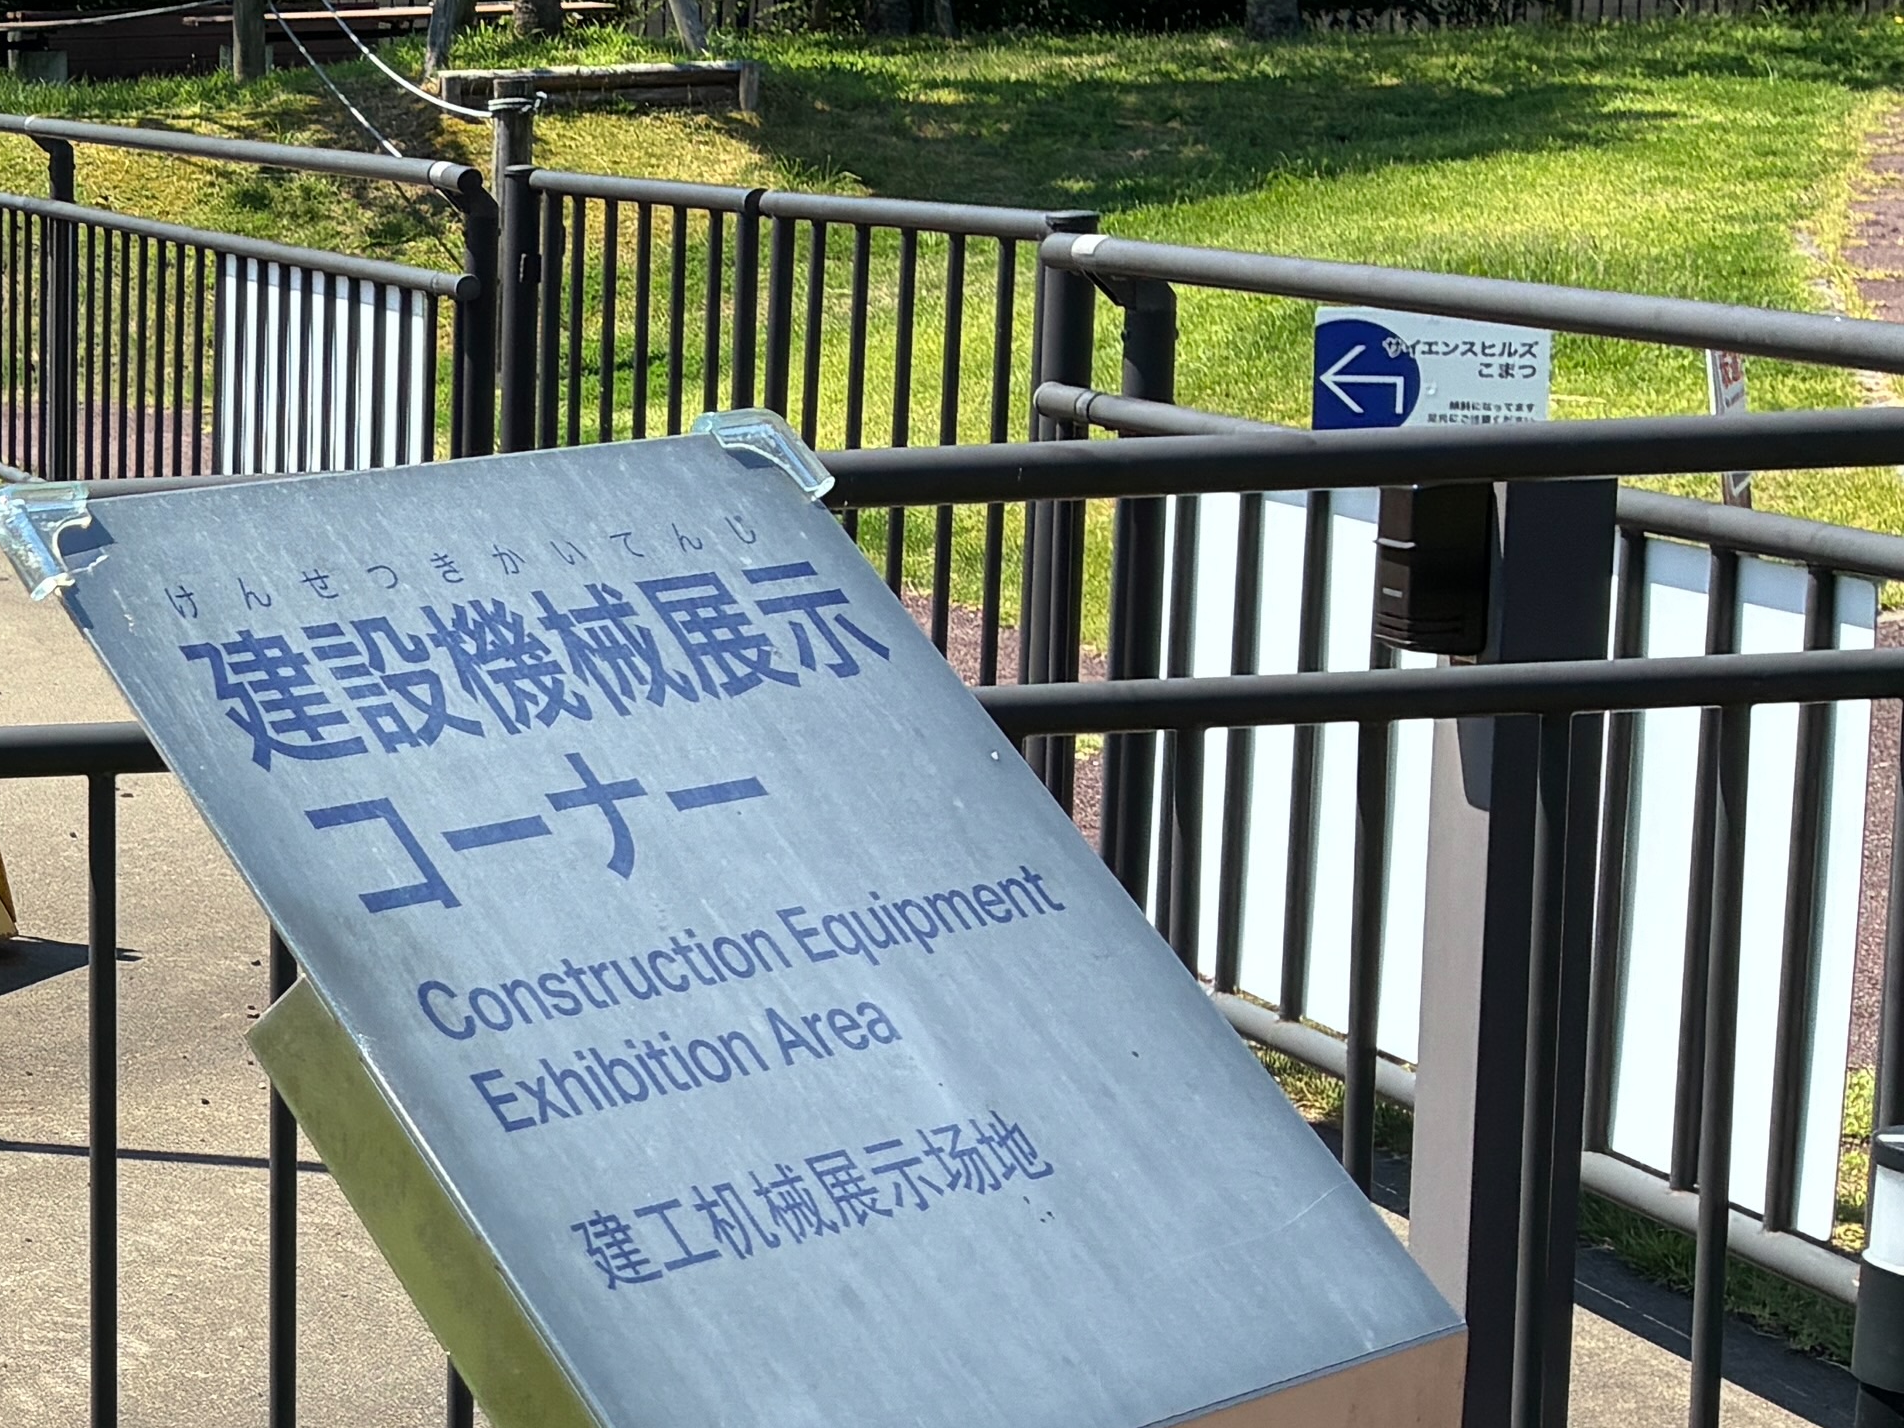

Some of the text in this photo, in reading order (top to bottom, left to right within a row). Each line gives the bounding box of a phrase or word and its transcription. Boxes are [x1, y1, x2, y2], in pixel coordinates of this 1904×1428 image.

[1382, 337, 1540, 358] サイエンスヒルズ
[1478, 362, 1537, 379] こまつ
[166, 515, 758, 620] けんせつきかいてんじ
[178, 560, 891, 772] 建設機械展示
[303, 751, 769, 914] コーナー
[416, 864, 1065, 1041] Construction Equipment
[470, 1000, 903, 1133] Exhibition Area
[571, 1109, 1055, 1290] 建工机械展示场地
